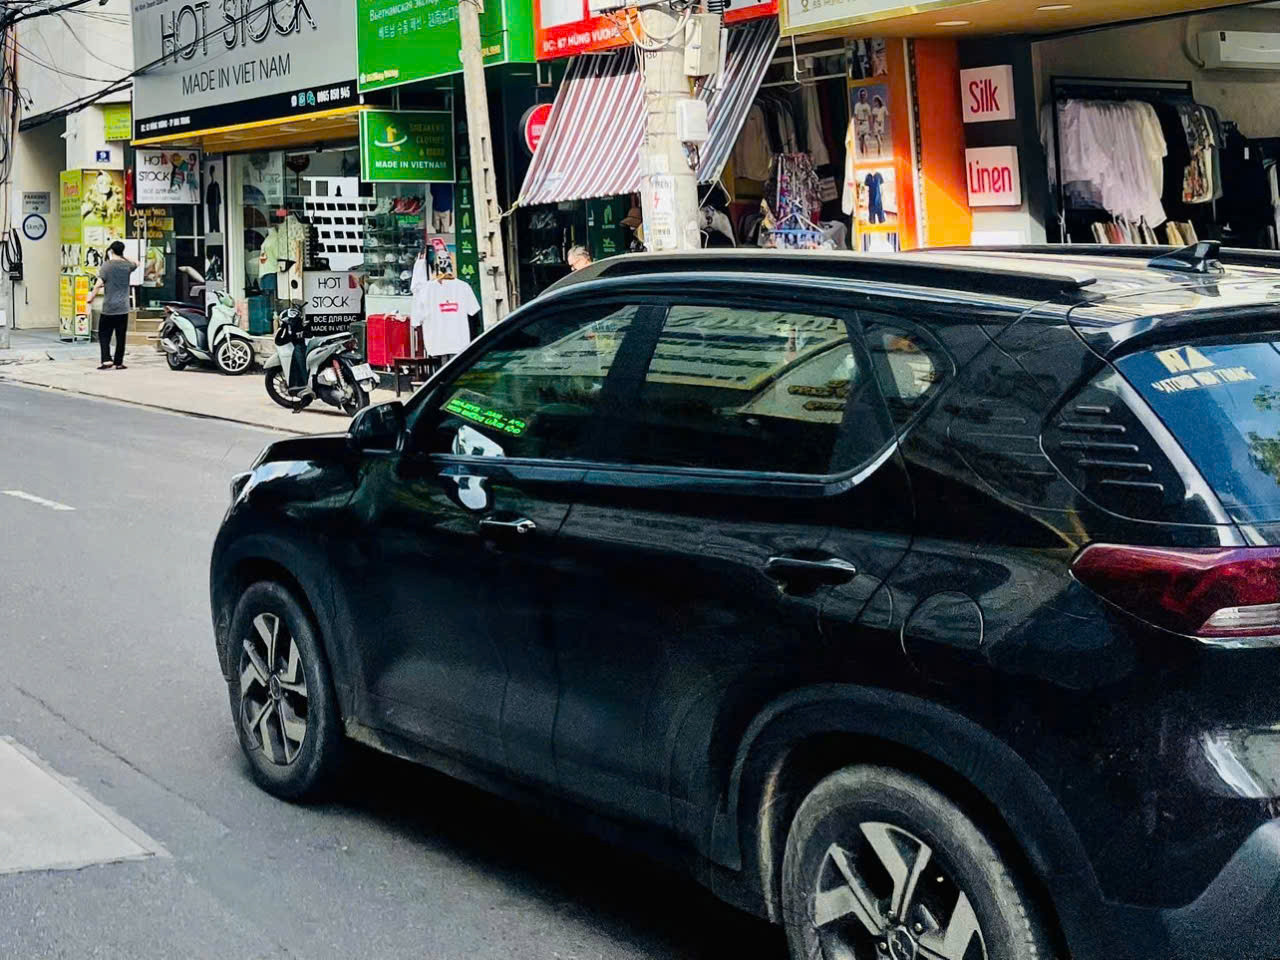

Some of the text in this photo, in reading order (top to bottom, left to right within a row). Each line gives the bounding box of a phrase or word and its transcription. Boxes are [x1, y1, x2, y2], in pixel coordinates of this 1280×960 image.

[160, 1, 210, 66] HOT
[182, 52, 291, 96] MADE IN VIET NAM
[969, 79, 1000, 113] Silk
[411, 161, 447, 169] VIETNAM
[138, 171, 170, 182] STOCK
[969, 160, 1012, 193] Linen
[318, 277, 341, 289] HOT
[312, 296, 349, 308] STOCK
[328, 315, 342, 323] ДЛЯ
